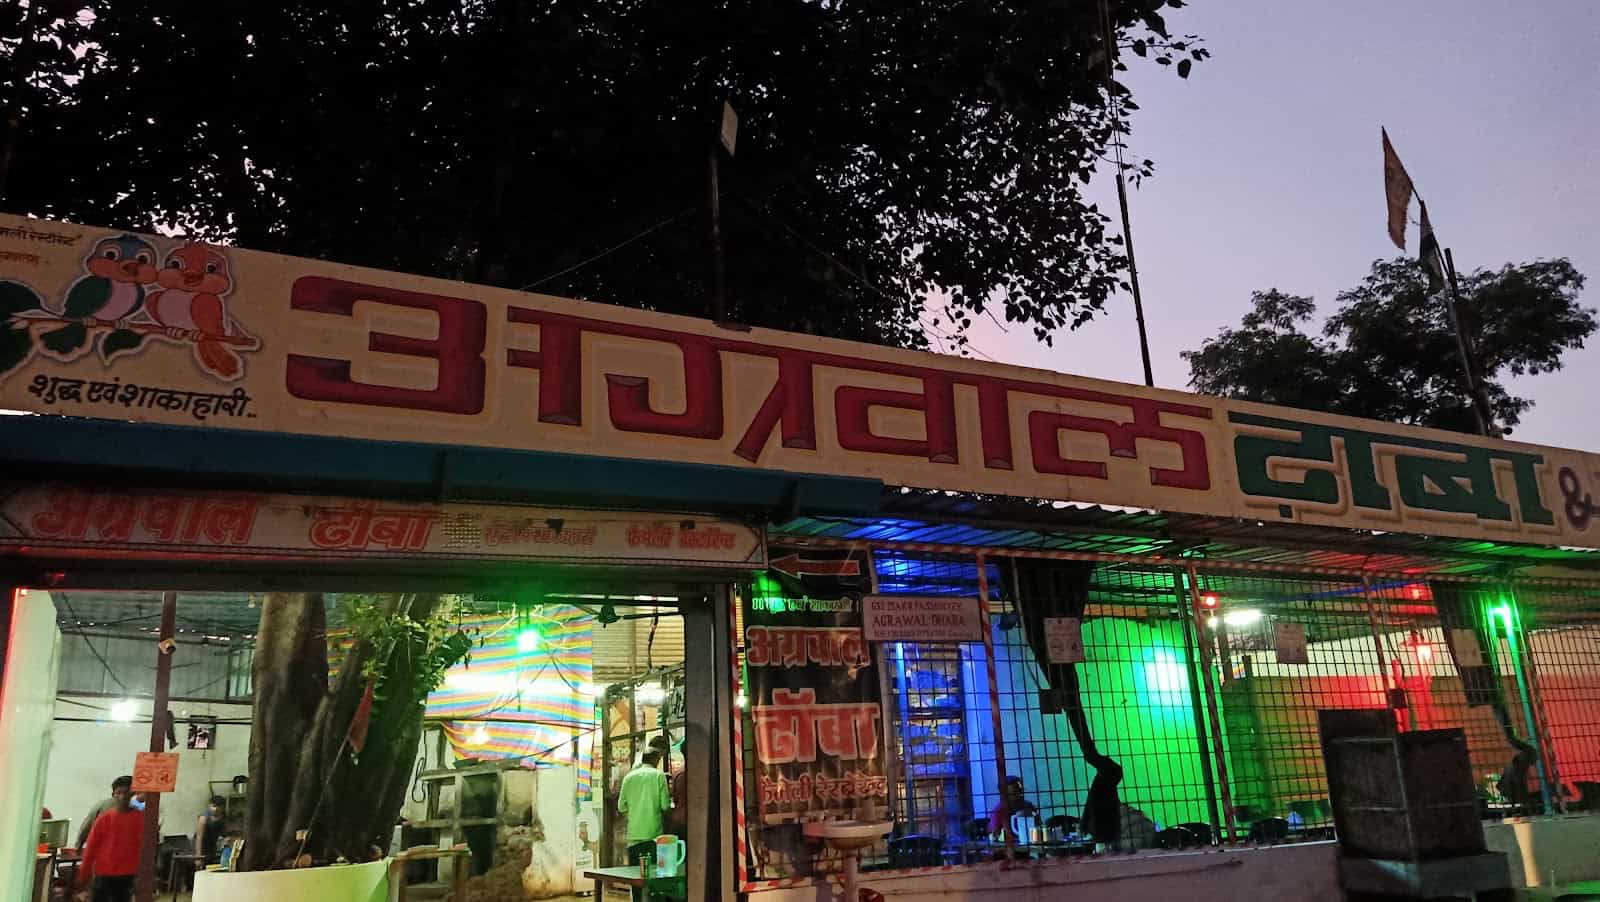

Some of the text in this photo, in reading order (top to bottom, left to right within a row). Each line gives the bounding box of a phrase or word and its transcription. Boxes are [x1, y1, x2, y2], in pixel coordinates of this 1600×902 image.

[28, 374, 87, 404] शुद्ध
[286, 275, 1213, 491] अग्रवाल
[872, 614, 967, 627] AGRAWAL DHABA
